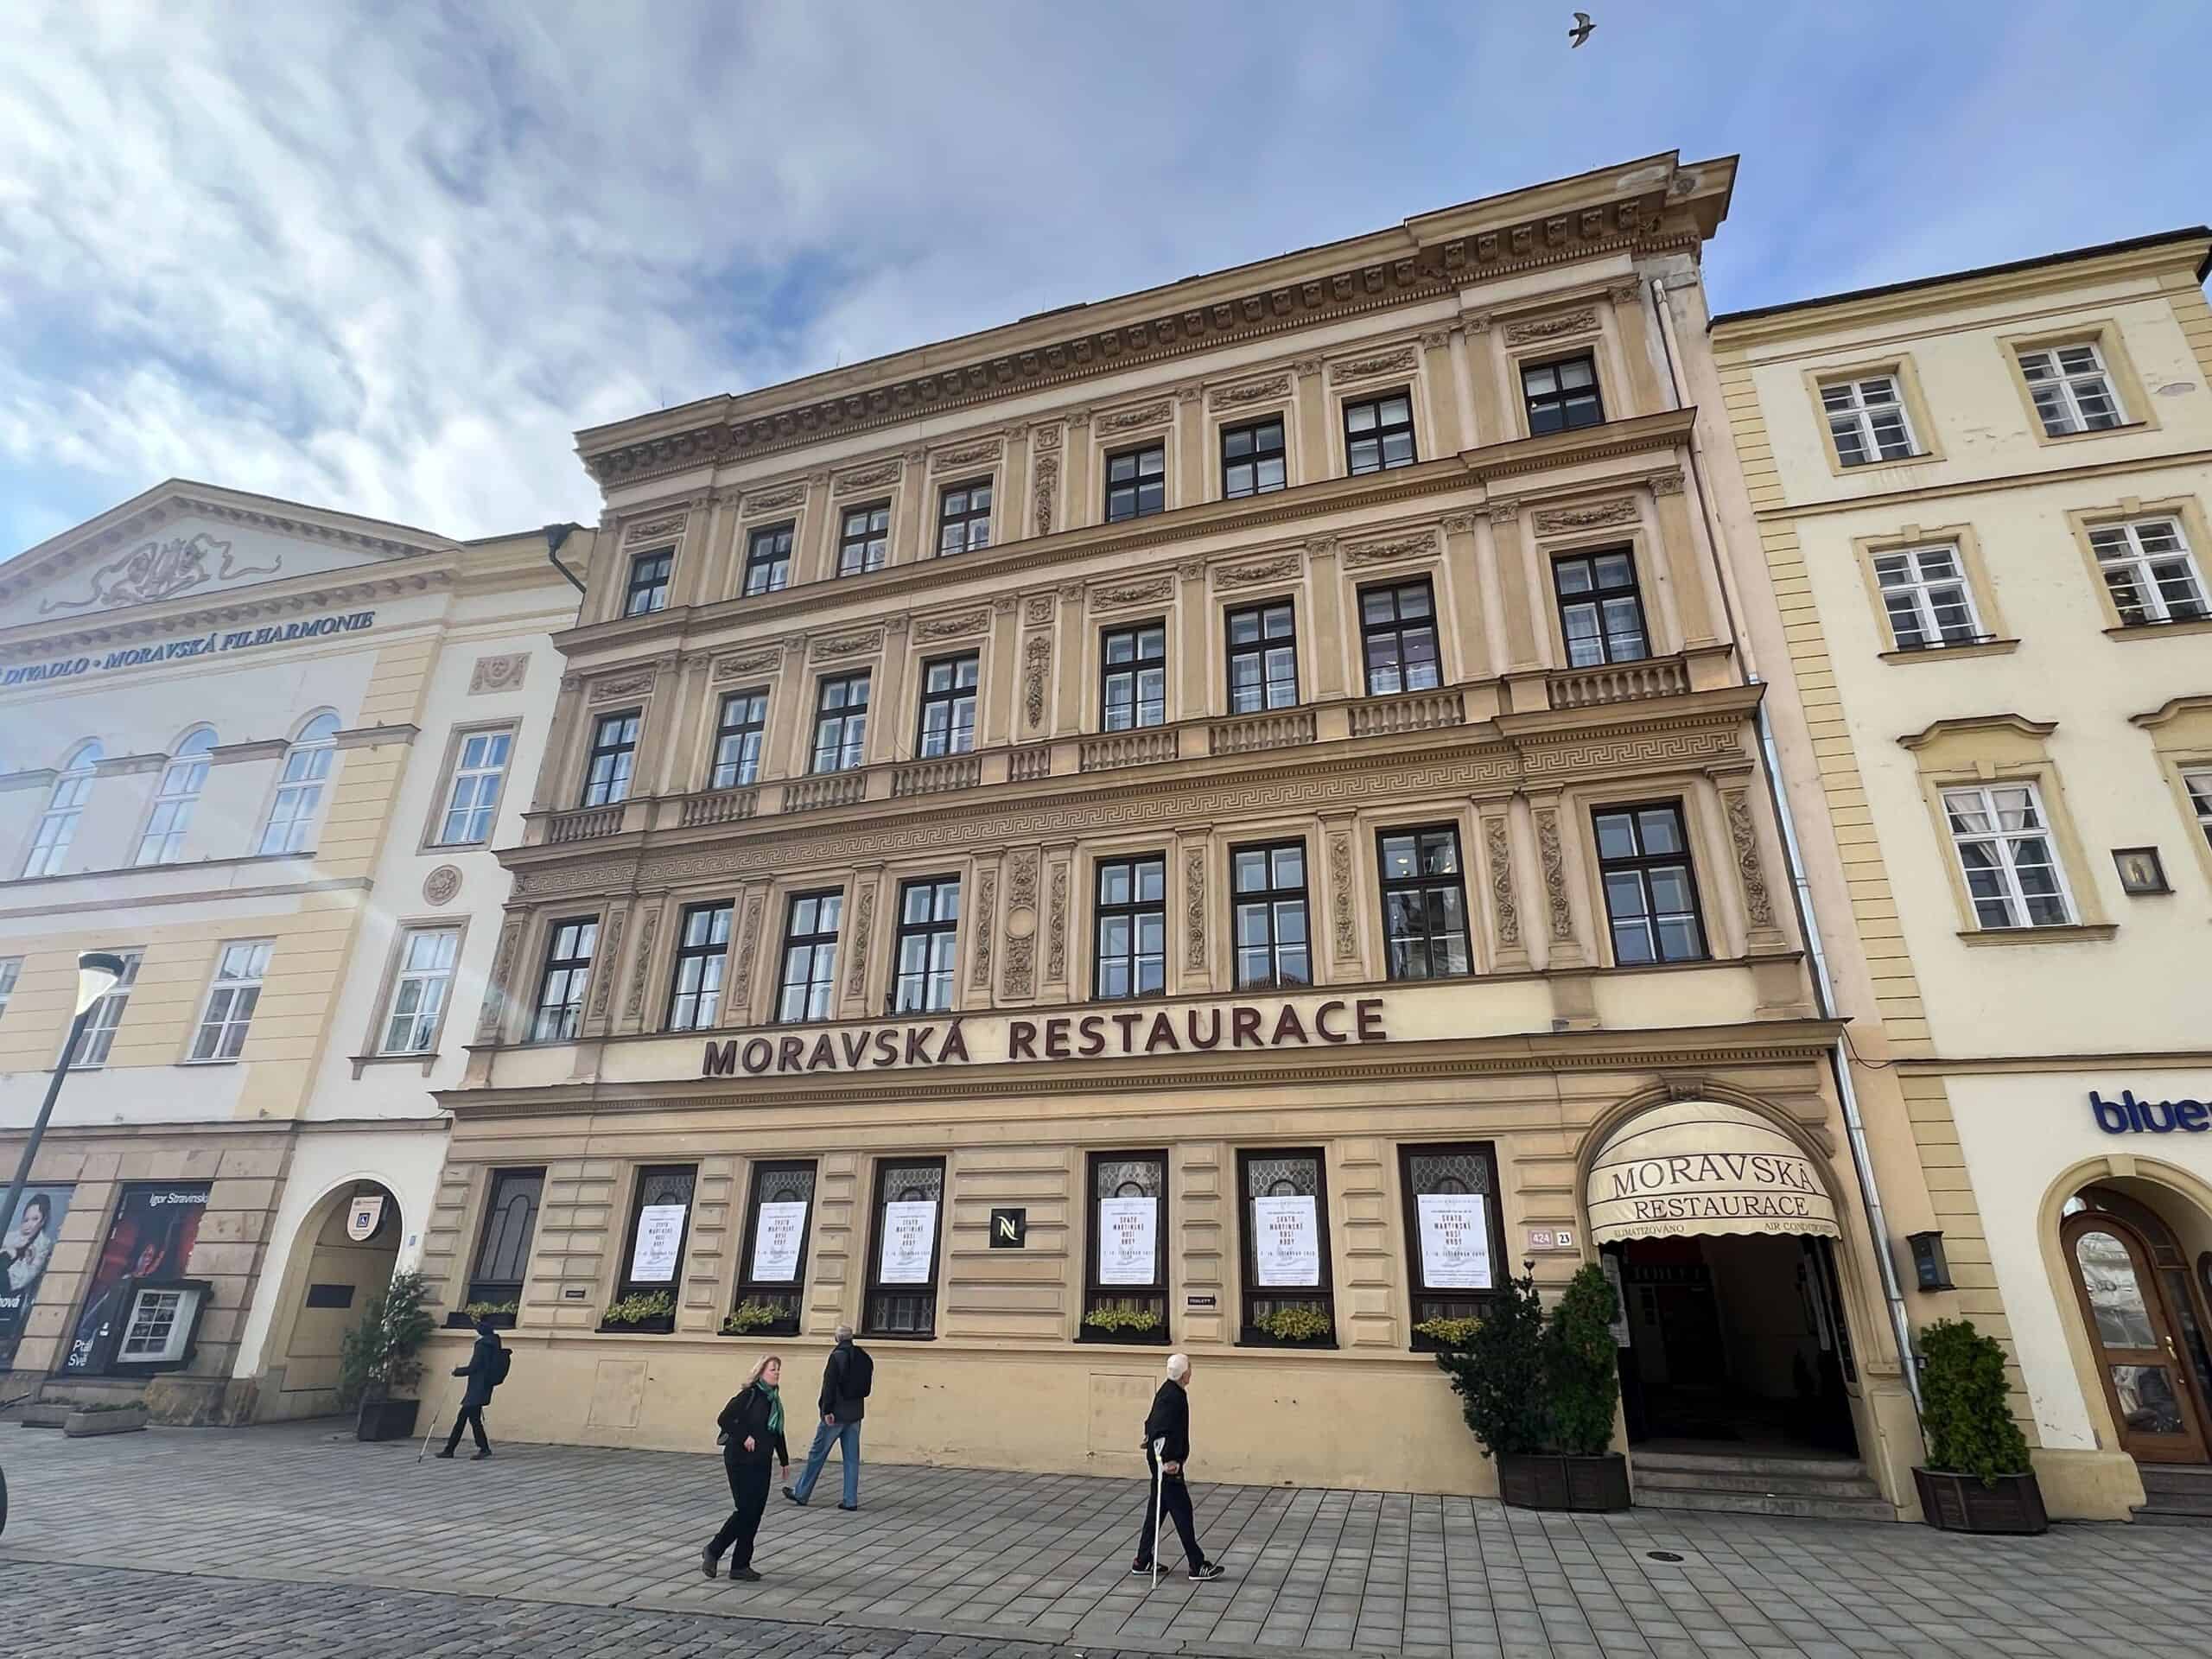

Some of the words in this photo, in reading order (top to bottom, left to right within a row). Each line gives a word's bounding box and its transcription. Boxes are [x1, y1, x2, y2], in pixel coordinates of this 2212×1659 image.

[4, 658, 90, 685] DIVADLO
[103, 632, 217, 670] MORAVSKÁ
[219, 611, 376, 651] FILHARMONIE
[702, 1017, 969, 1076] MORAVSKÁ
[1009, 999, 1387, 1058] RESTAURACE
[2089, 1090, 2212, 1134] blue
[1612, 1154, 1819, 1198] MORAVSKÁ
[149, 1193, 168, 1207] Igor
[1633, 1196, 1809, 1219] RESTAURACE
[1533, 1233, 1550, 1243] 424
[1559, 1234, 1570, 1243] 23
